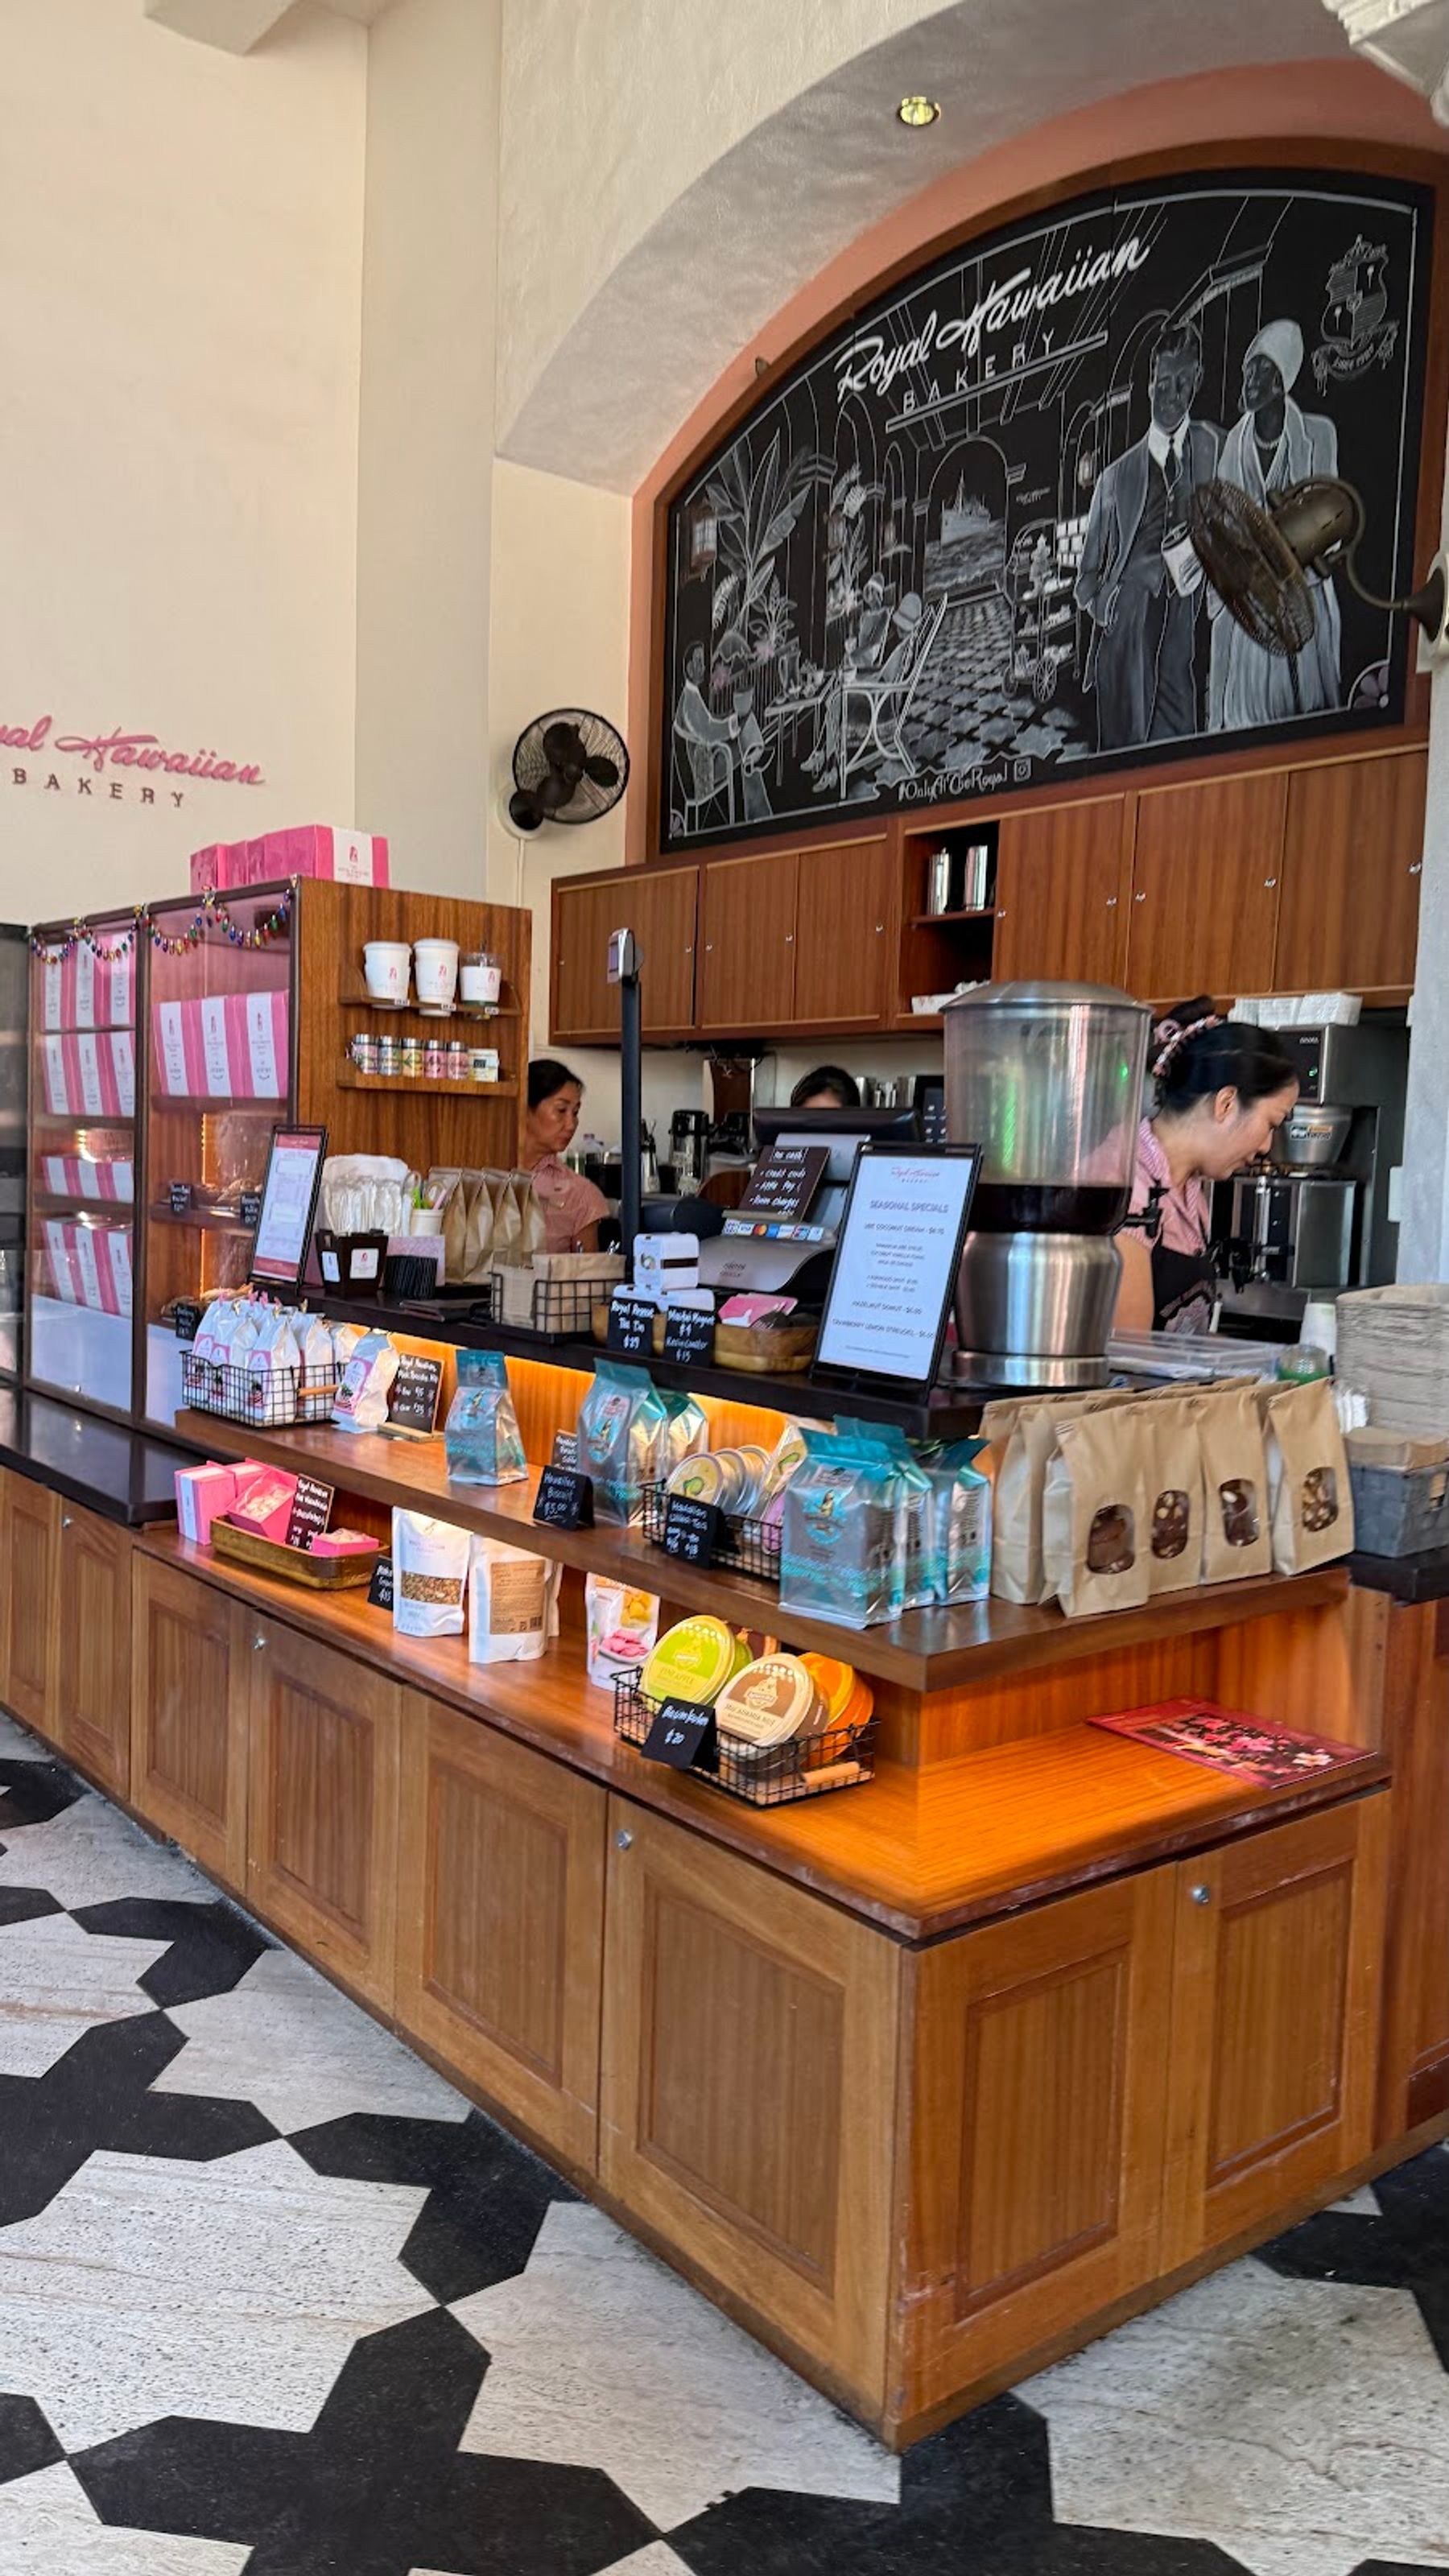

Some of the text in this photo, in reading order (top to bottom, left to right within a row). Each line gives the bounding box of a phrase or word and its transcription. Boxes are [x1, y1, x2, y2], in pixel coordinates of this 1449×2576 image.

[834, 237, 1150, 402] Royal Hawaiian
[903, 328, 1055, 415] BAKERY
[54, 726, 265, 786] Hawaiian
[11, 767, 184, 807] BAKERY
[869, 1199, 949, 1213] SEASONAL SPECIALS
